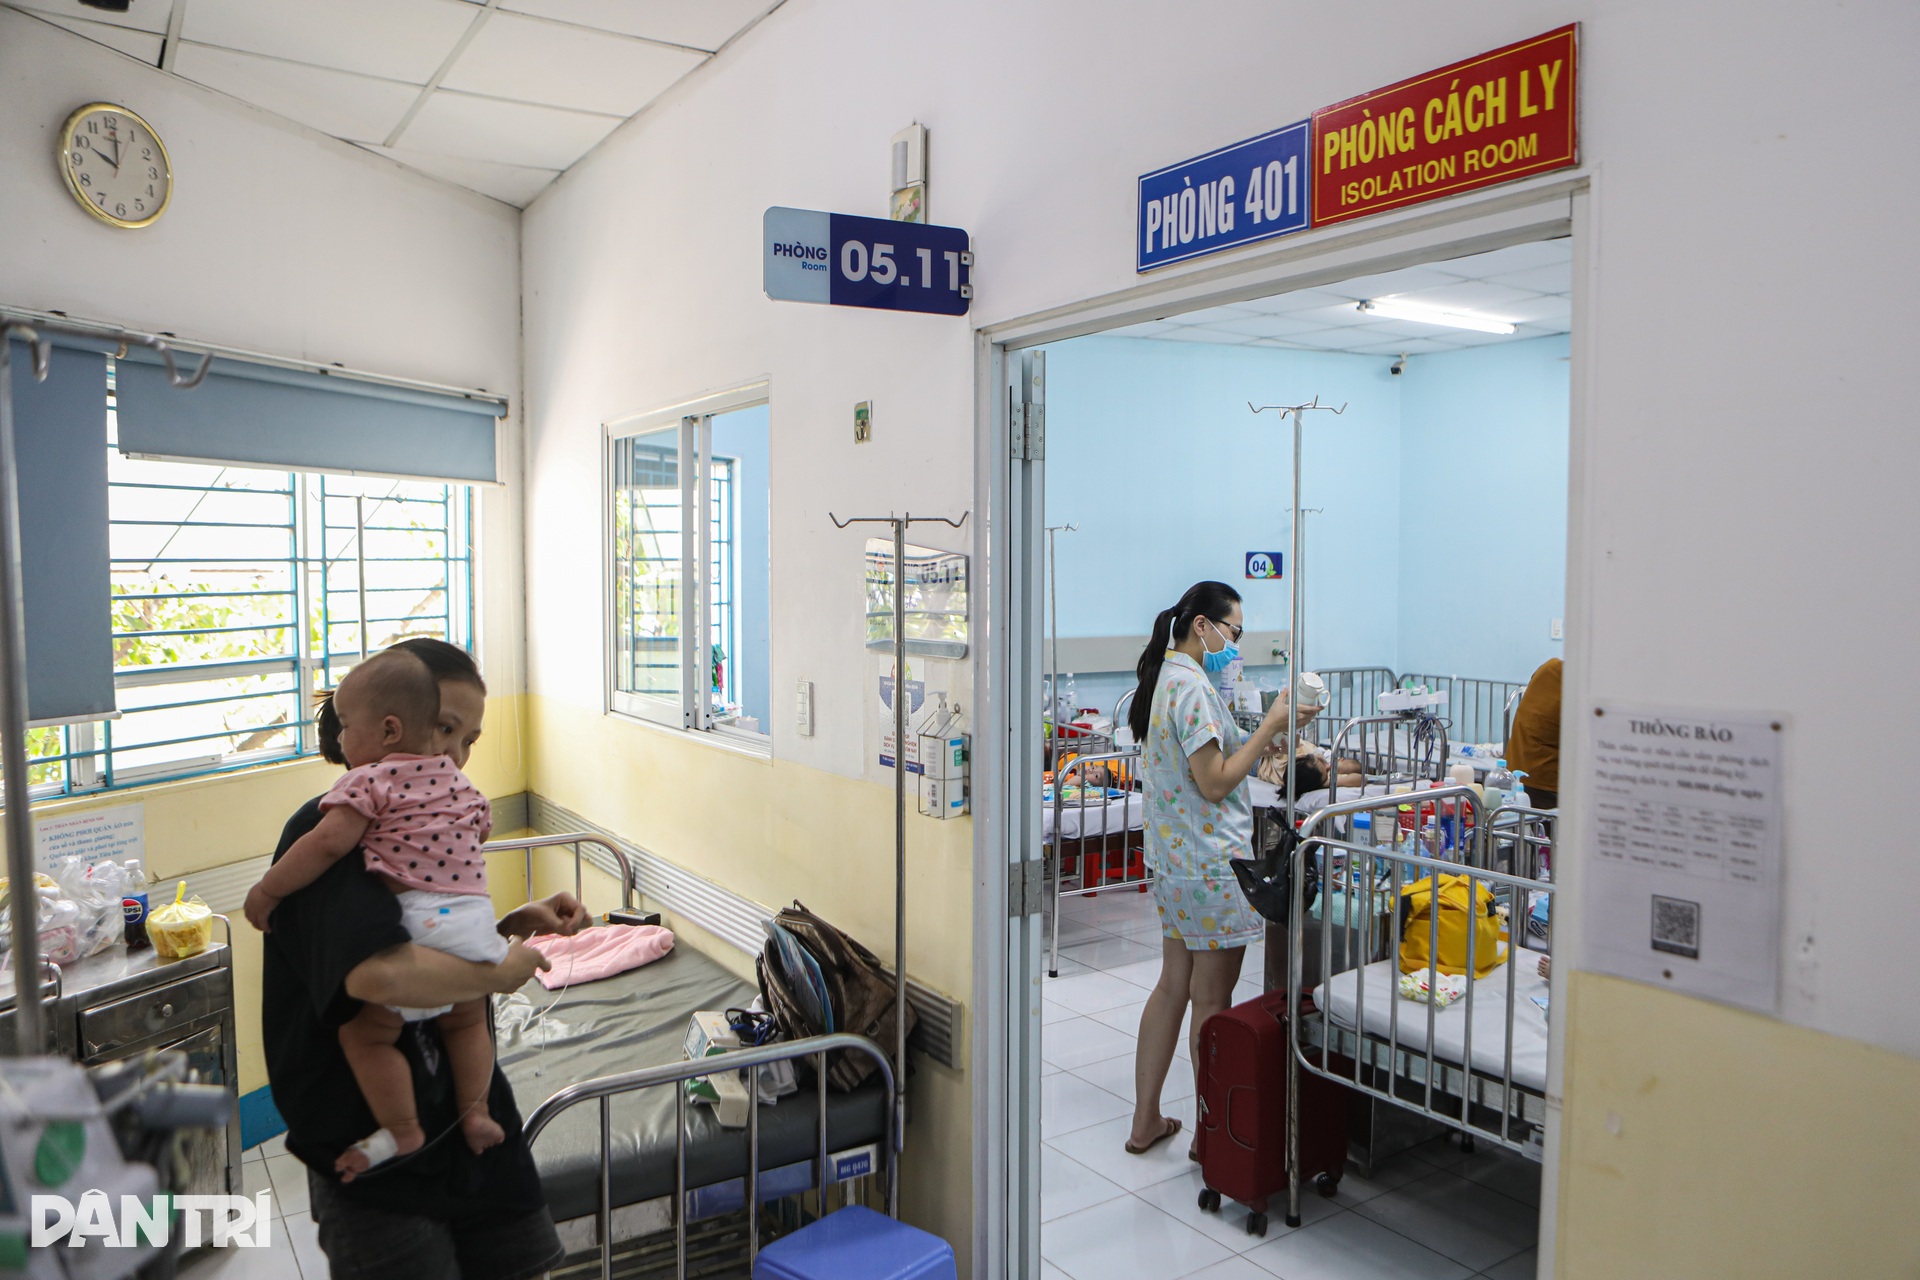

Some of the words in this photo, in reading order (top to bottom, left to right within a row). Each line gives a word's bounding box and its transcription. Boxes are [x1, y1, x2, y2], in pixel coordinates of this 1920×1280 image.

[104, 117, 117, 131] 12
[1323, 108, 1415, 175] PHÒNG
[1423, 78, 1507, 144] CÁCH
[1519, 59, 1563, 118] LY
[88, 121, 98, 134] 11
[75, 134, 90, 149] 10
[130, 130, 135, 142] 1
[72, 152, 83, 166] 9
[142, 148, 151, 161] 2
[148, 166, 158, 180] 3
[1341, 155, 1456, 205] ISOLATION
[1464, 132, 1538, 173] ROOM
[80, 173, 91, 187] 8
[145, 184, 154, 198] 4
[97, 192, 107, 205] 7
[135, 198, 145, 212] 5
[1146, 176, 1235, 254] PHÒNG
[1244, 155, 1298, 225] 401
[116, 203, 126, 216] 6
[773, 241, 828, 261] PHÒNG
[841, 239, 959, 291] 05.11
[802, 261, 827, 272] Room
[1252, 560, 1266, 572] 04
[1629, 718, 1690, 739] THÔNG
[1694, 724, 1733, 742] BÁO
